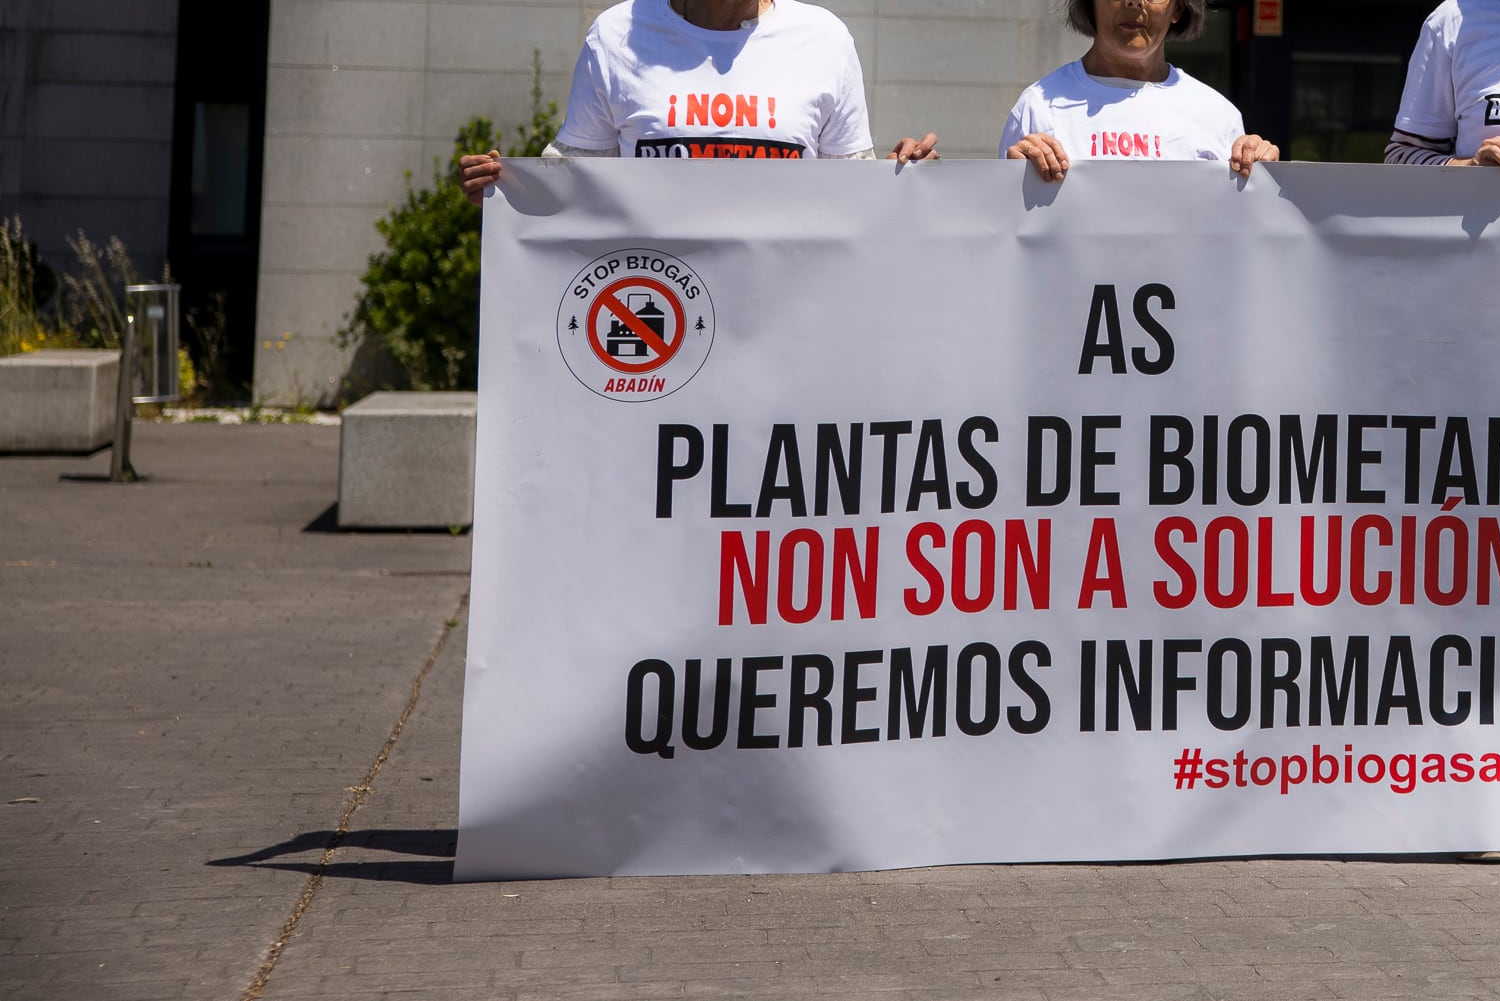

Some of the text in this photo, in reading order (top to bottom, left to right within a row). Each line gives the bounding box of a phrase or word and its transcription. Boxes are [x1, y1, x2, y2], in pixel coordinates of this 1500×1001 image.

[573, 258, 621, 300] STOP
[1078, 282, 1176, 376] AS
[603, 374, 666, 393] ABADÍN
[655, 415, 1000, 519] PLANTAS
[1025, 414, 1122, 507] DE
[718, 525, 881, 626] NON
[903, 518, 1052, 616] SON
[1077, 517, 1129, 610] A
[624, 639, 1053, 760] QUEREMOS
